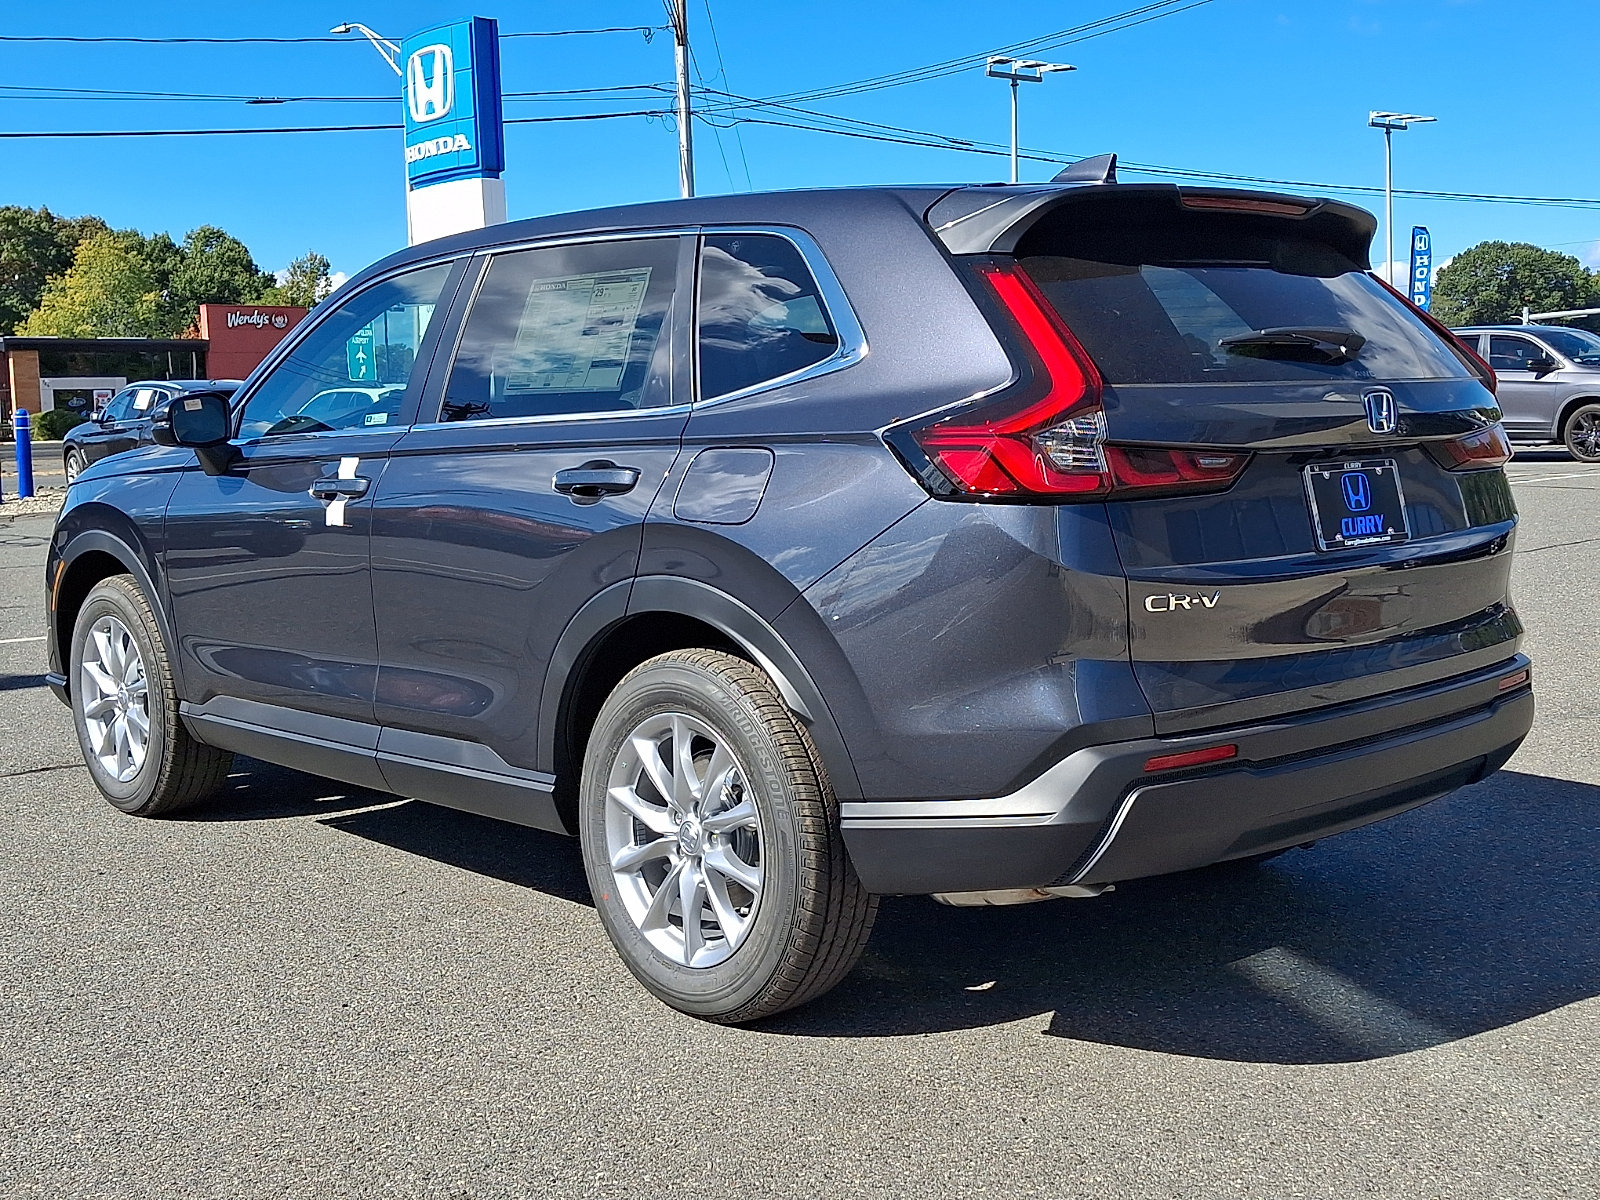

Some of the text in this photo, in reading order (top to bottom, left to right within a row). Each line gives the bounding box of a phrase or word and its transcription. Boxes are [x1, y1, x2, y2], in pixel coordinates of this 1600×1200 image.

[406, 133, 472, 164] HONDA
[1414, 255, 1429, 307] HOND
[227, 310, 269, 328] Wendy's
[1344, 462, 1362, 470] CURRY
[1341, 514, 1384, 536] CURRY
[1145, 590, 1220, 612] CR-V
[719, 690, 789, 820] BRIDGESTONE
